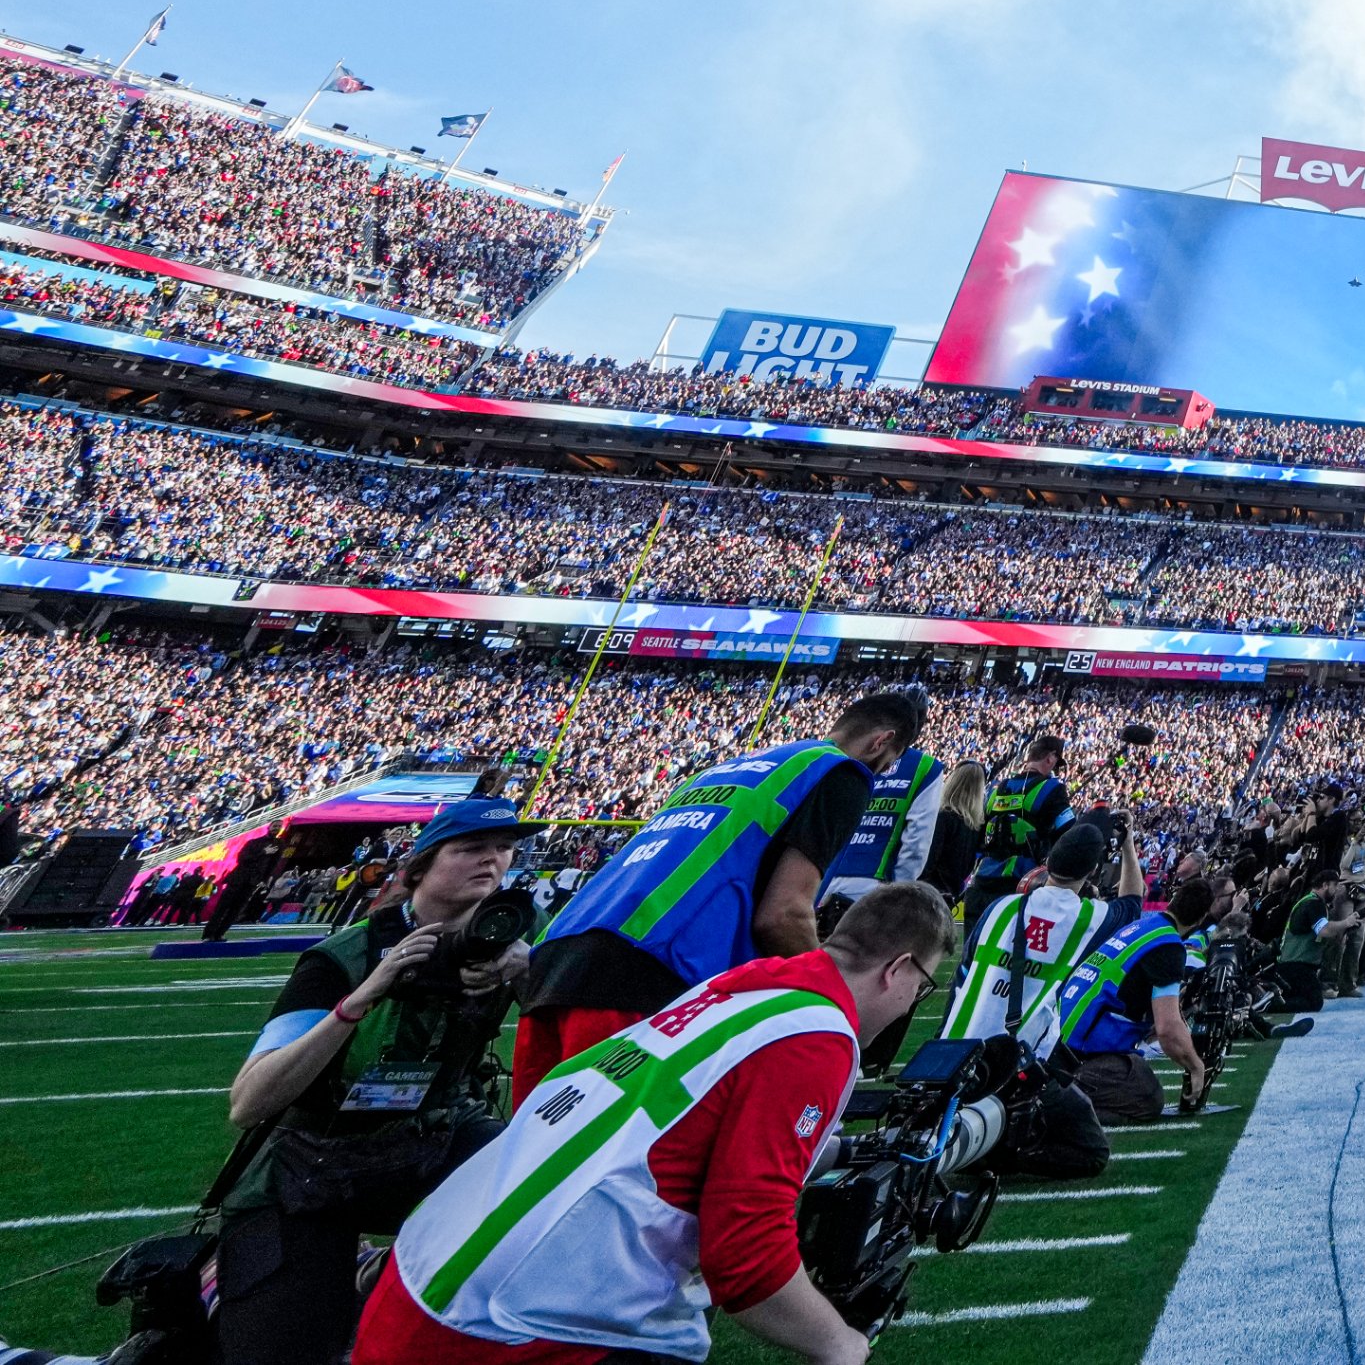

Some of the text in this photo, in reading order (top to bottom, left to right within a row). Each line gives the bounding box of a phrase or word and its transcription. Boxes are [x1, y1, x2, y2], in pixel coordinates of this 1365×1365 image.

[739, 320, 858, 361] BUD
[706, 351, 869, 390] LIGHT
[1112, 383, 1161, 396] STADIUM
[641, 636, 680, 649] SEATTLE
[681, 638, 831, 656] SEAHAWKS
[1068, 654, 1265, 675] 25 NEW ENGLAND PATRIOTS
[874, 779, 911, 789] LMS
[868, 798, 897, 811] 0:00
[860, 815, 893, 827] MERA
[623, 839, 669, 867] 003
[998, 951, 1043, 977] 0000
[535, 1084, 587, 1126] 006
[799, 1115, 816, 1135] NFL
